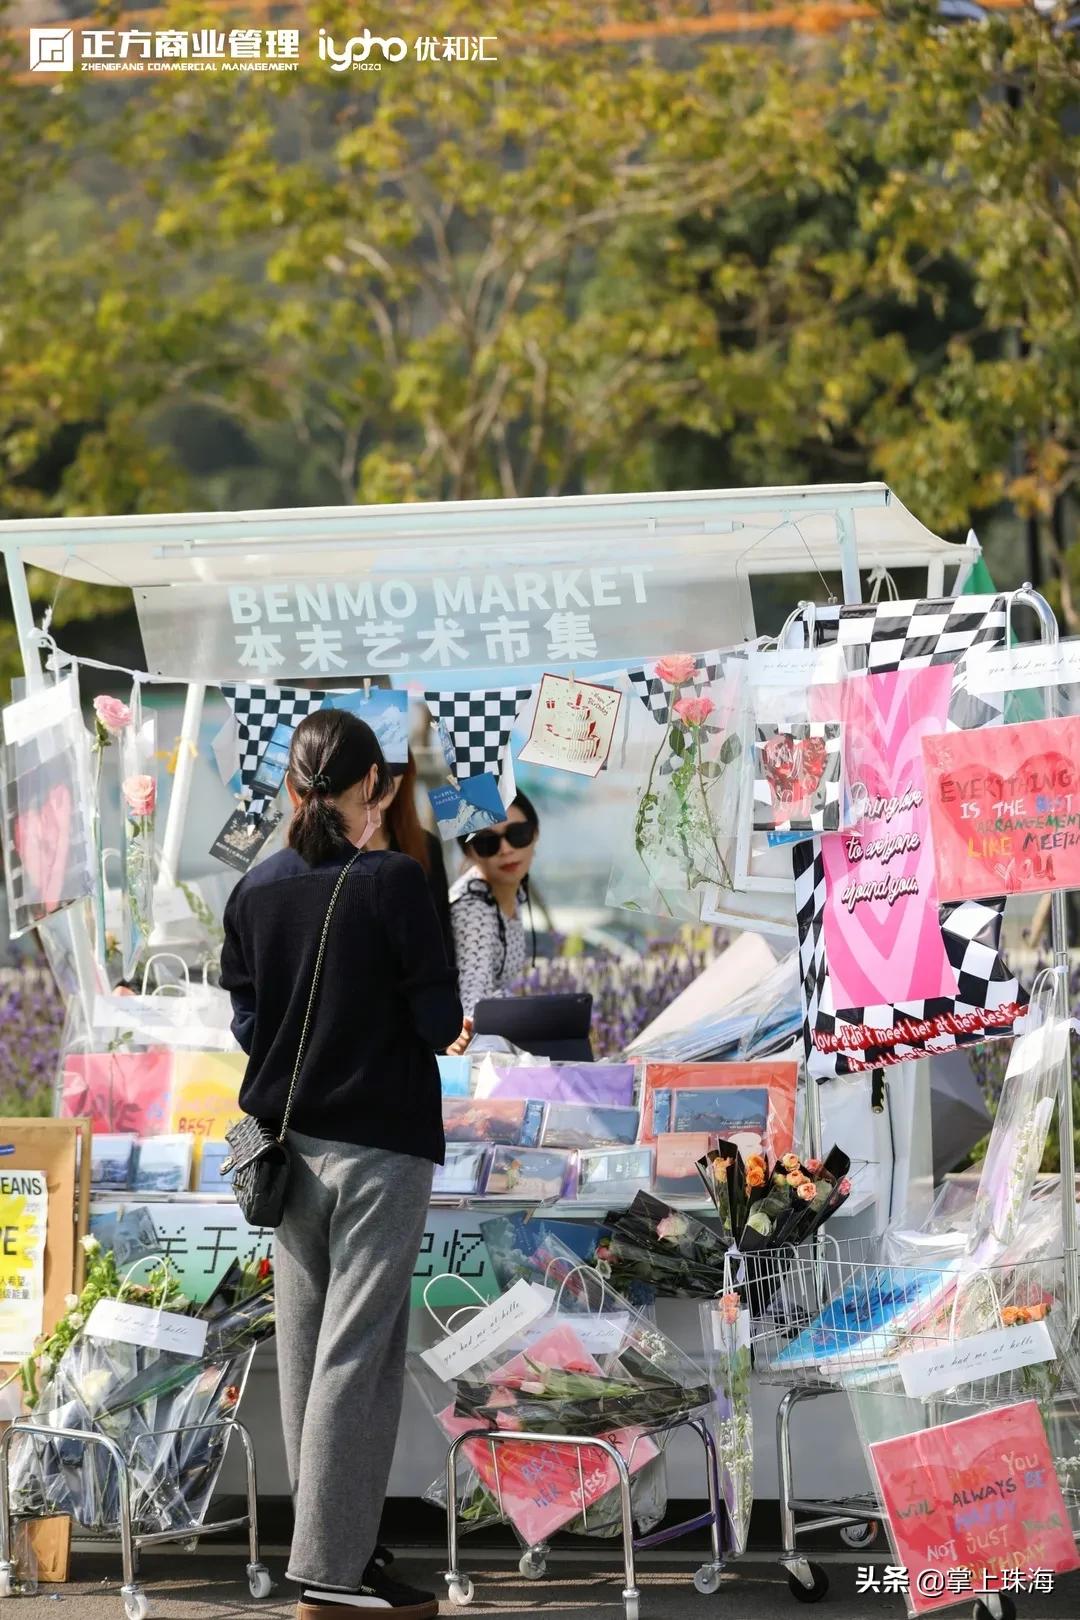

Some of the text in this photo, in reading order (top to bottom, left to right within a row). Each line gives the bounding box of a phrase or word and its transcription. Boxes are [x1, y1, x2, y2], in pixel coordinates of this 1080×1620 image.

[228, 564, 654, 624] BENMO MARKET
[234, 611, 598, 674] 本末艺术市集
[940, 768, 1073, 803] EVERYTHING
[960, 802, 981, 819] IS
[992, 799, 1027, 818] THE
[845, 835, 864, 863] to
[968, 836, 1014, 859] LIKE
[811, 1028, 838, 1052] love
[875, 1022, 907, 1043] meet
[908, 1018, 931, 1036] her
[935, 1014, 951, 1034] at
[950, 1012, 976, 1031] her
[952, 1477, 1017, 1508] ALWAYS
[927, 1539, 958, 1562] NOT
